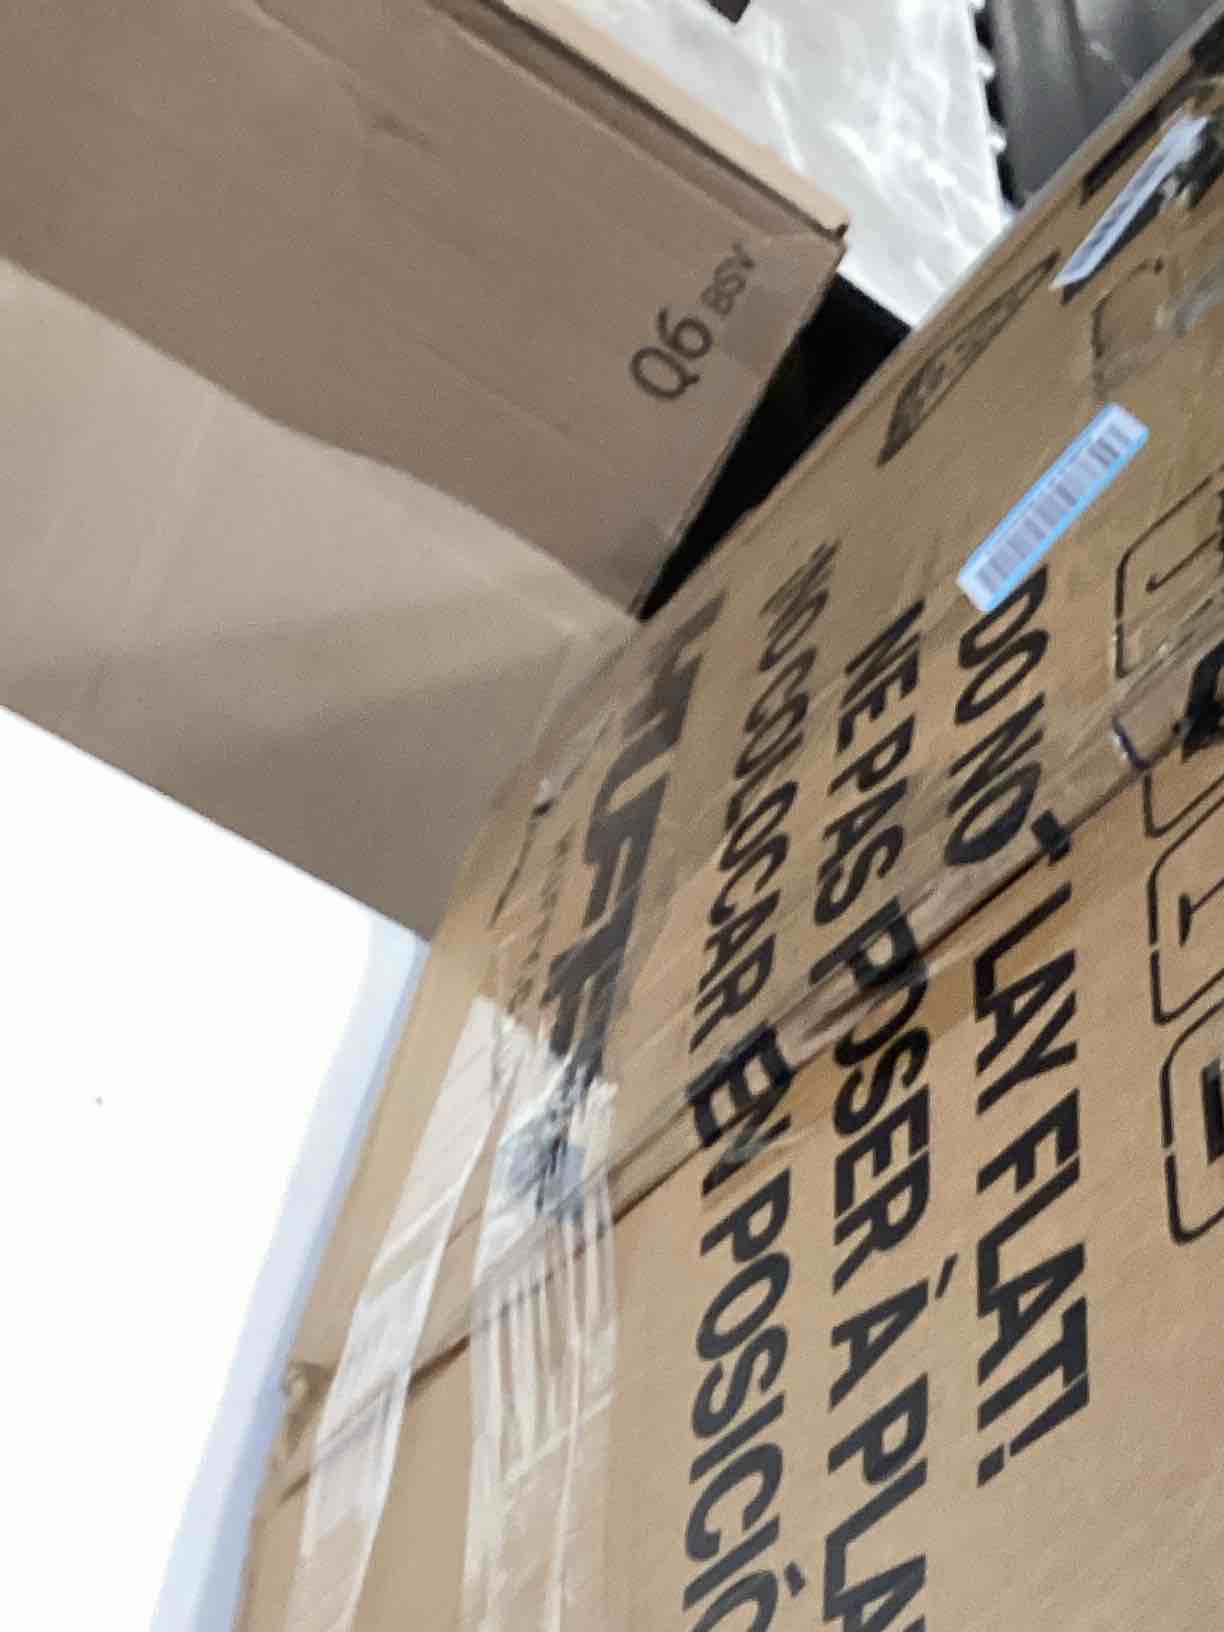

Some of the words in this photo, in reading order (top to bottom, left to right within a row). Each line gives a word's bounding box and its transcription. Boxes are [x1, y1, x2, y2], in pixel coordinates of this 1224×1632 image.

[629, 305, 713, 401] Q6
[836, 600, 925, 753] NE
[954, 564, 1050, 724] DO
[690, 646, 818, 1054] COLOCAR
[814, 715, 916, 925] PAS
[972, 883, 1078, 1114] LAY
[687, 1022, 798, 1196] EN
[809, 897, 932, 1294] POSER
[828, 1252, 958, 1413] À
[975, 1088, 1090, 1488] FLAT!
